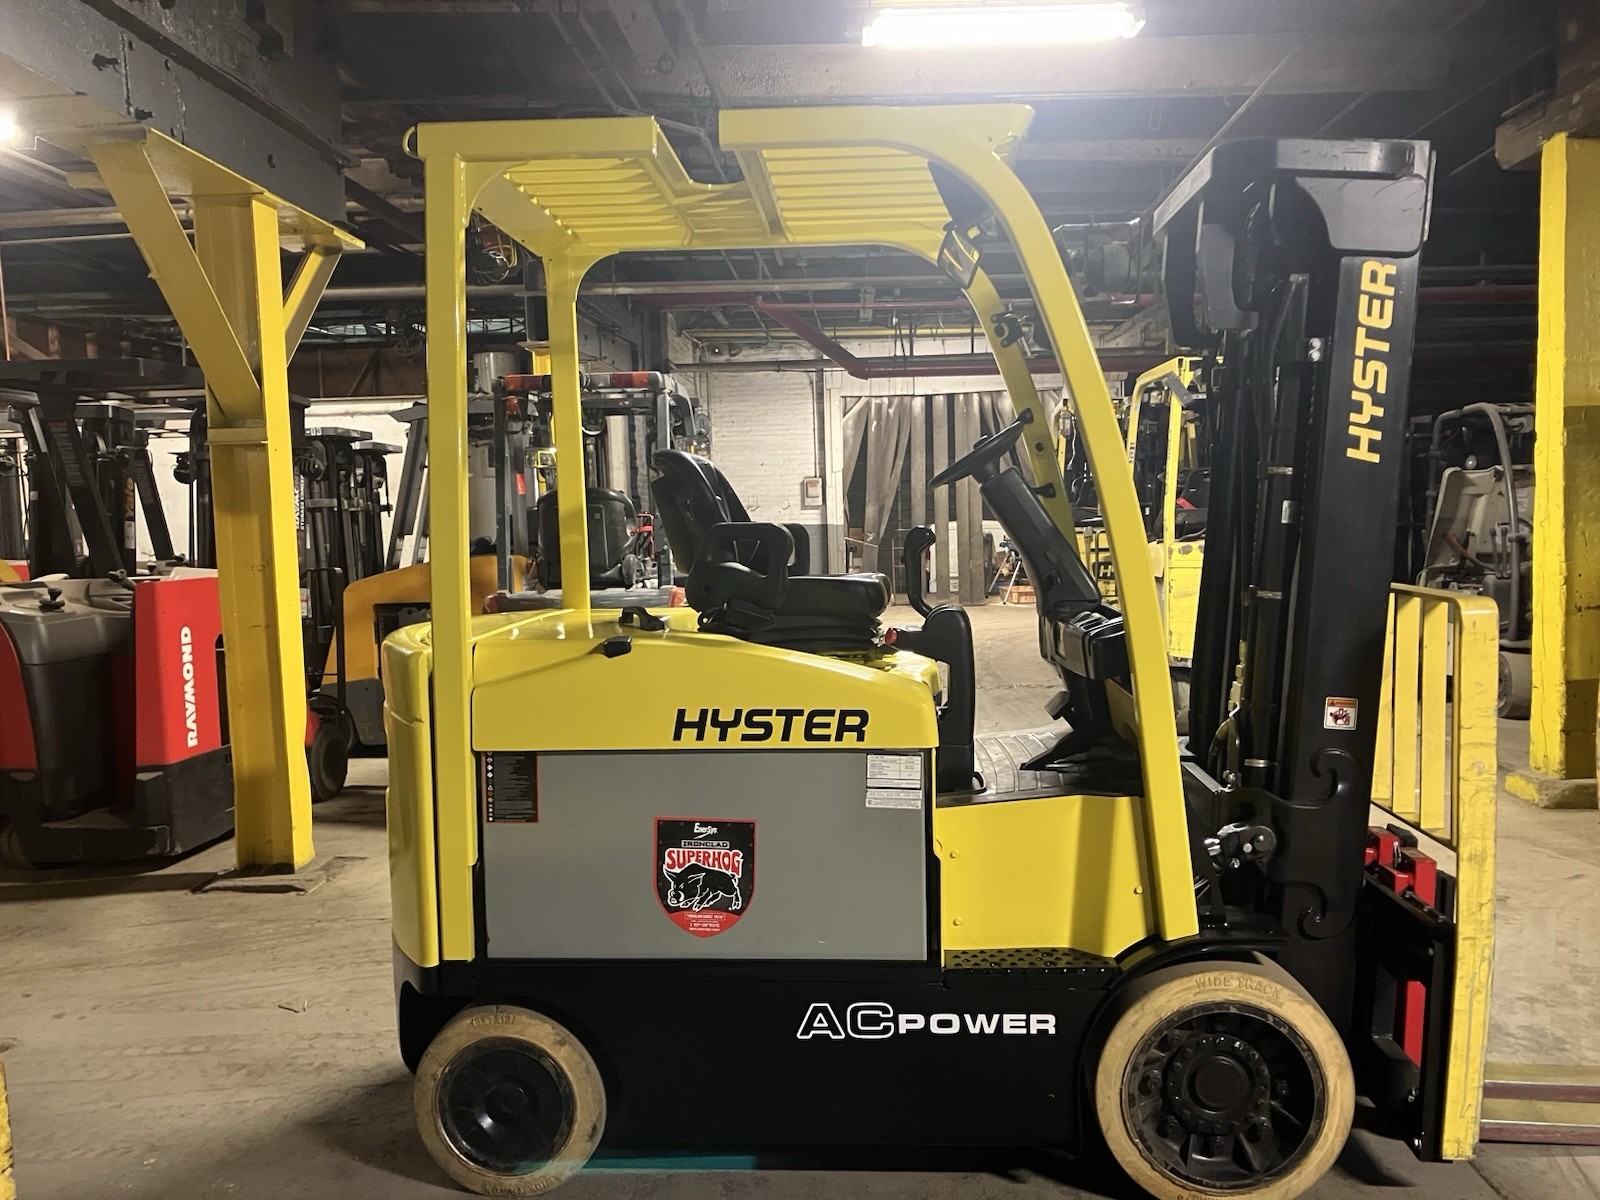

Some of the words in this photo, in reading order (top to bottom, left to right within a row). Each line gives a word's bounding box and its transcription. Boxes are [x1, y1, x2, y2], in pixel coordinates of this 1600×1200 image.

[1347, 260, 1397, 463] HYSTER
[181, 626, 198, 747] RAYMOND
[672, 708, 869, 742] HYSTER
[693, 822, 719, 837] EnerSys
[666, 849, 740, 876] SUPERHOG
[1195, 976, 1231, 989] WIDE
[1238, 977, 1280, 999] TRACK
[797, 1003, 894, 1039] AC
[898, 1013, 1056, 1034] POWER
